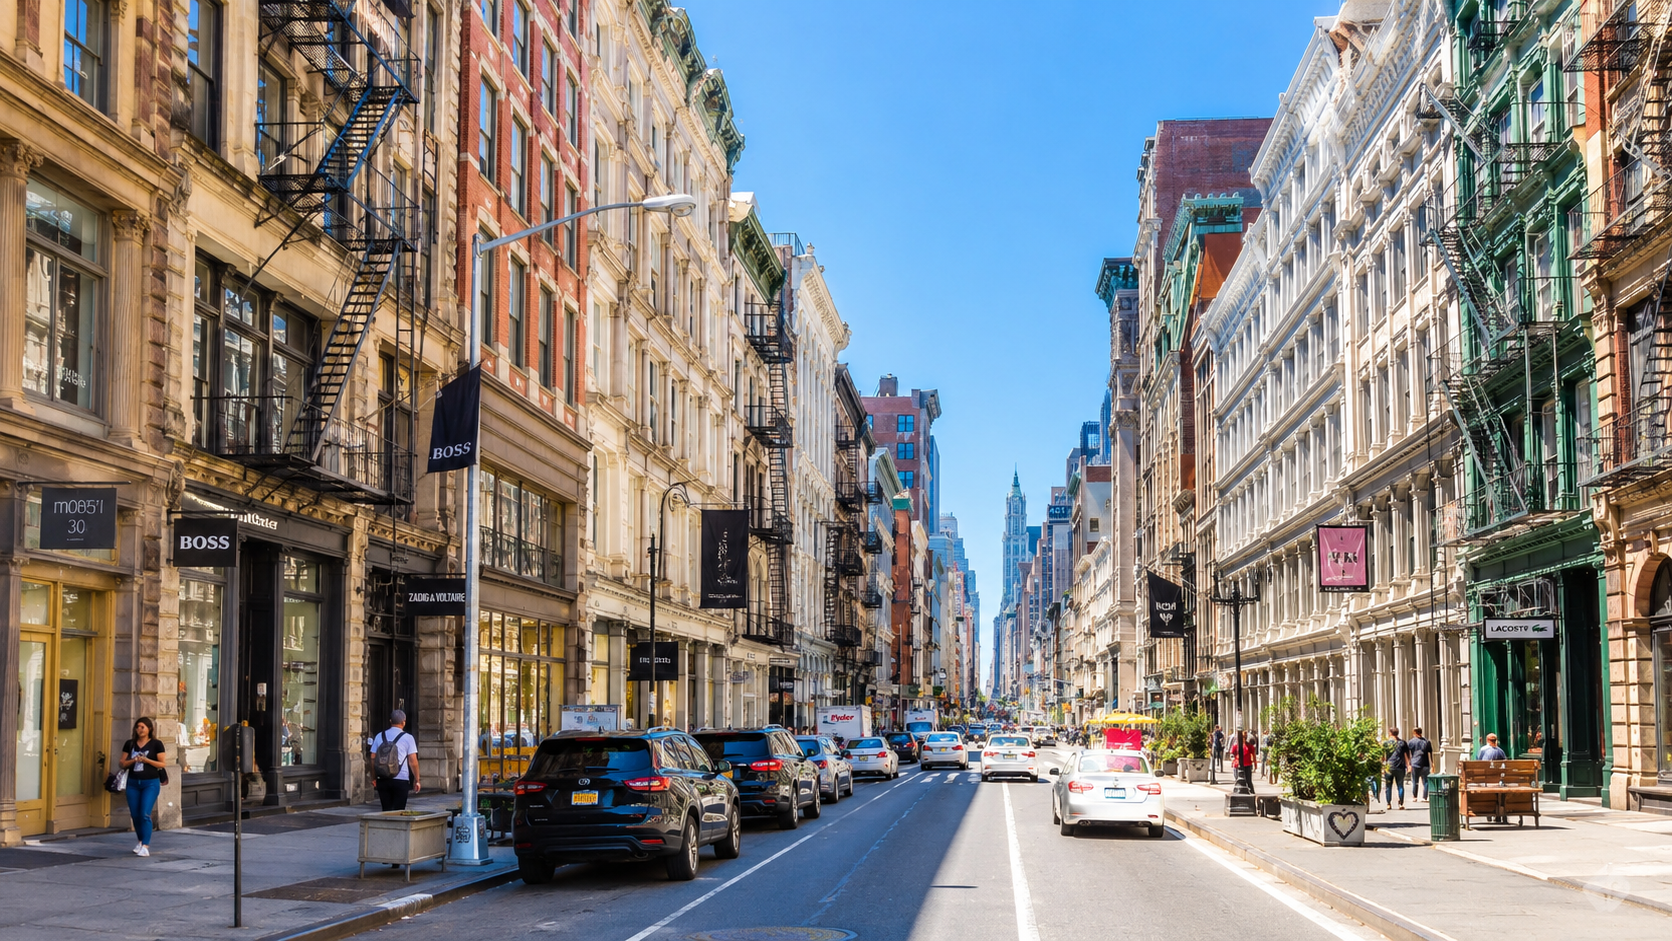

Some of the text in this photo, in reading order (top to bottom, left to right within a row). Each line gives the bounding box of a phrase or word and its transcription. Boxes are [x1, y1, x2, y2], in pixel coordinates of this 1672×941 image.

[432, 441, 472, 460] BOSS
[67, 518, 86, 534] 30
[179, 535, 230, 550] BOSS
